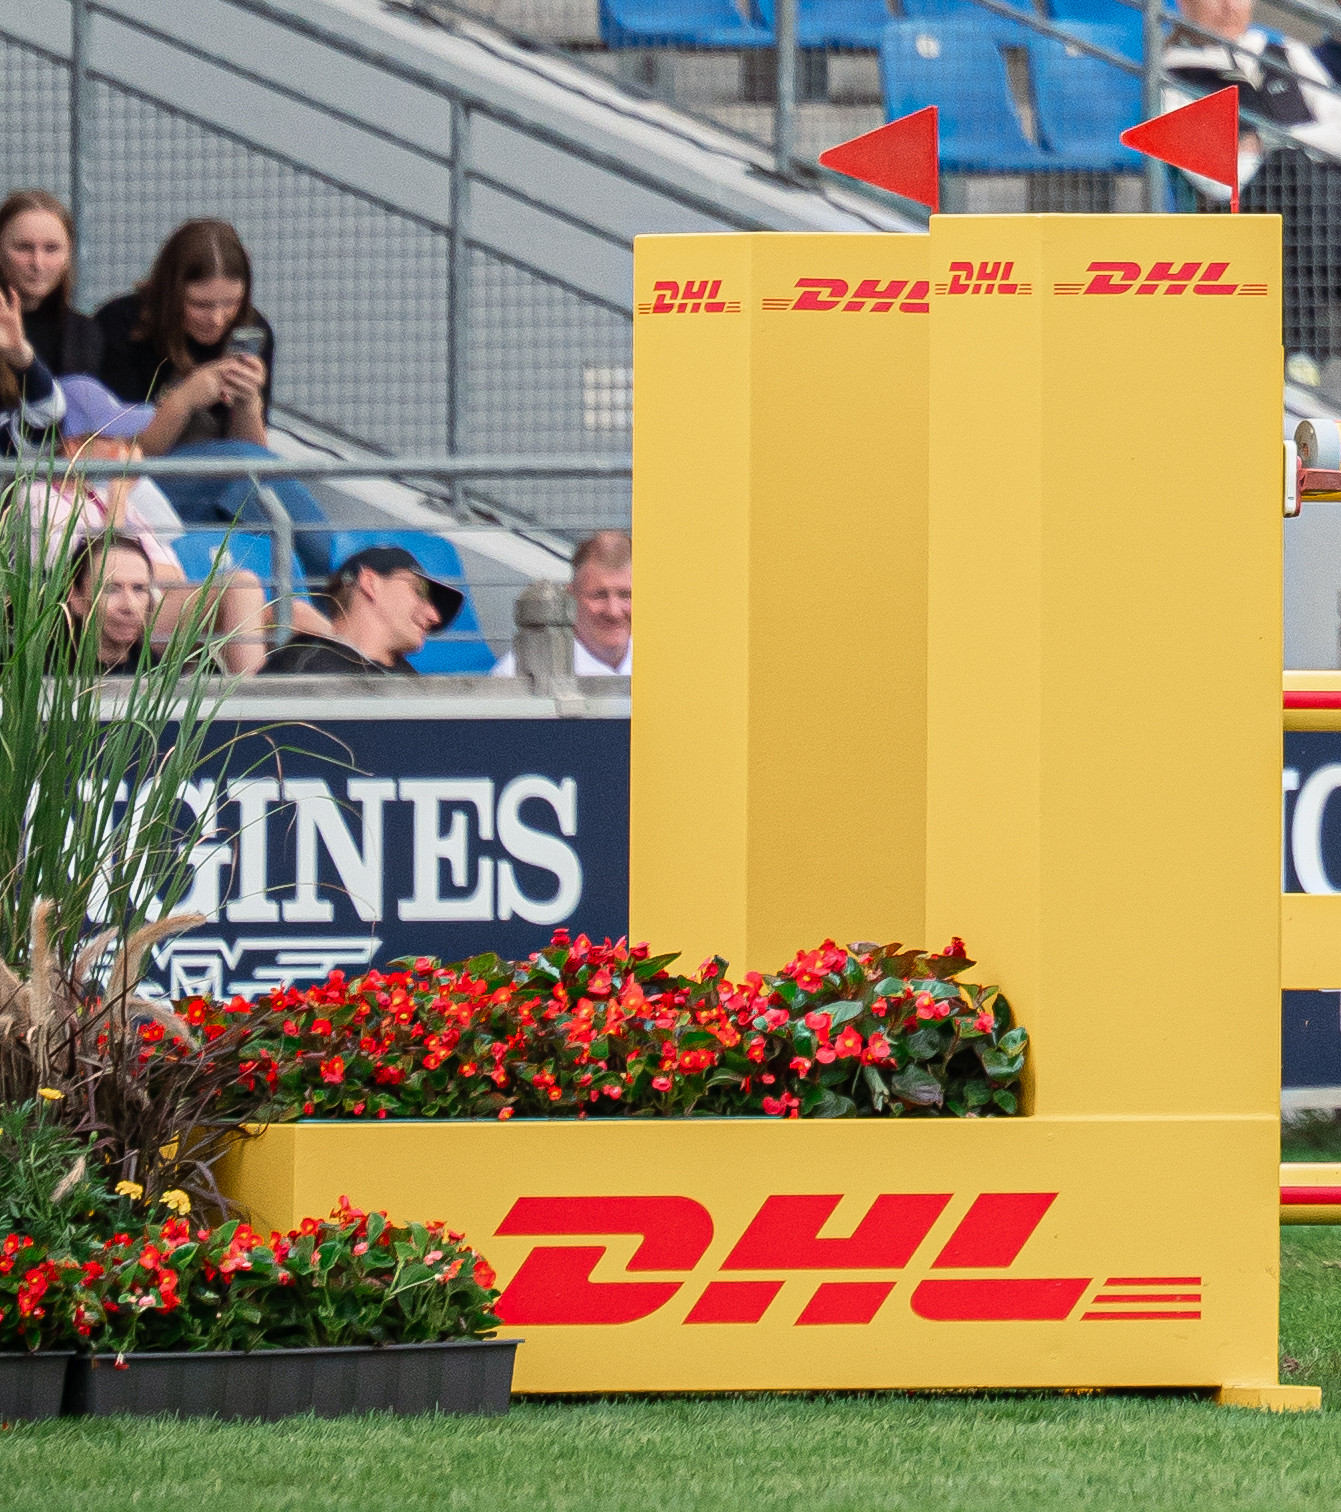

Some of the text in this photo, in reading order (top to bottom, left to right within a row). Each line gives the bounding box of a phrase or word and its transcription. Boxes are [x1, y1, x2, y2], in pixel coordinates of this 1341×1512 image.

[947, 261, 1019, 295] DHL
[1083, 261, 1239, 296] DHL
[652, 279, 726, 314] DHL
[489, 1191, 1094, 1327] DHL
